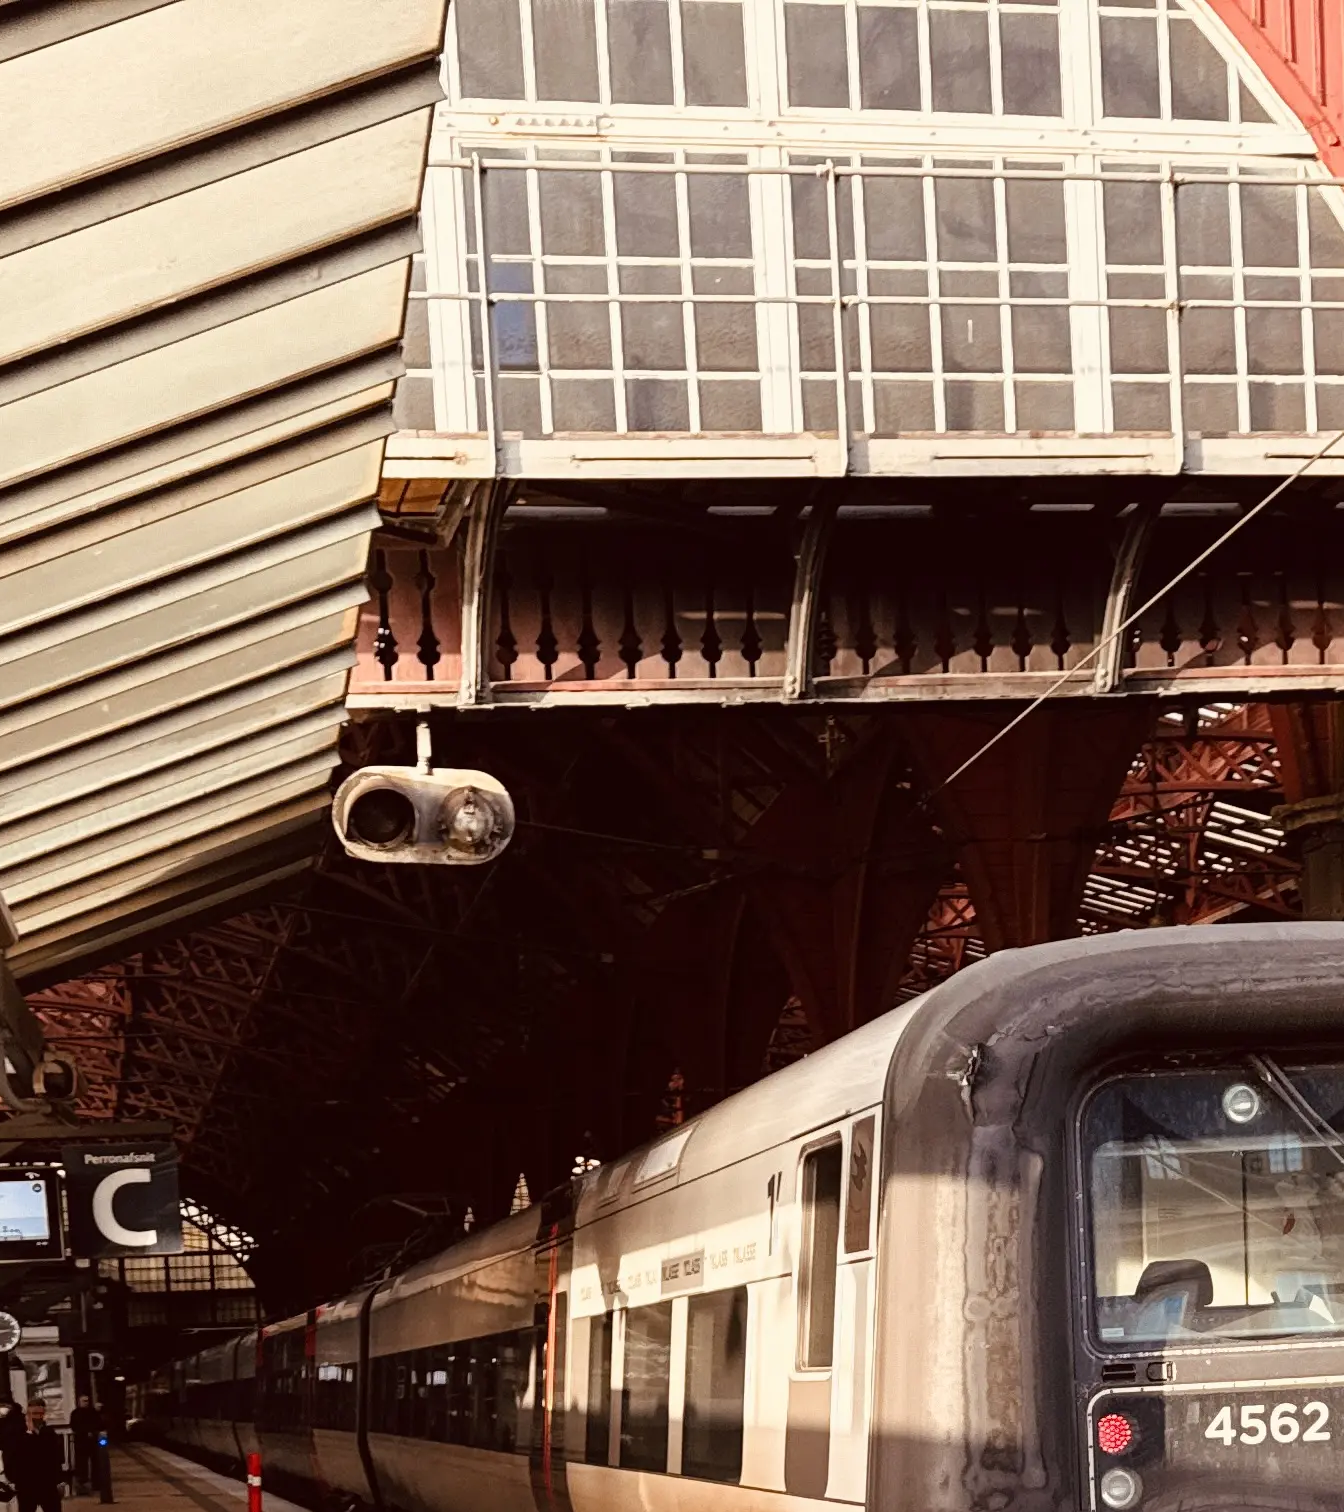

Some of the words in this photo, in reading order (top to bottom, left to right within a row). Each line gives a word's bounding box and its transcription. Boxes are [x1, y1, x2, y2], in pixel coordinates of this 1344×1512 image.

[84, 1152, 156, 1165] Perronafsnit
[92, 1168, 157, 1247] C
[1205, 1400, 1332, 1446] 4562
